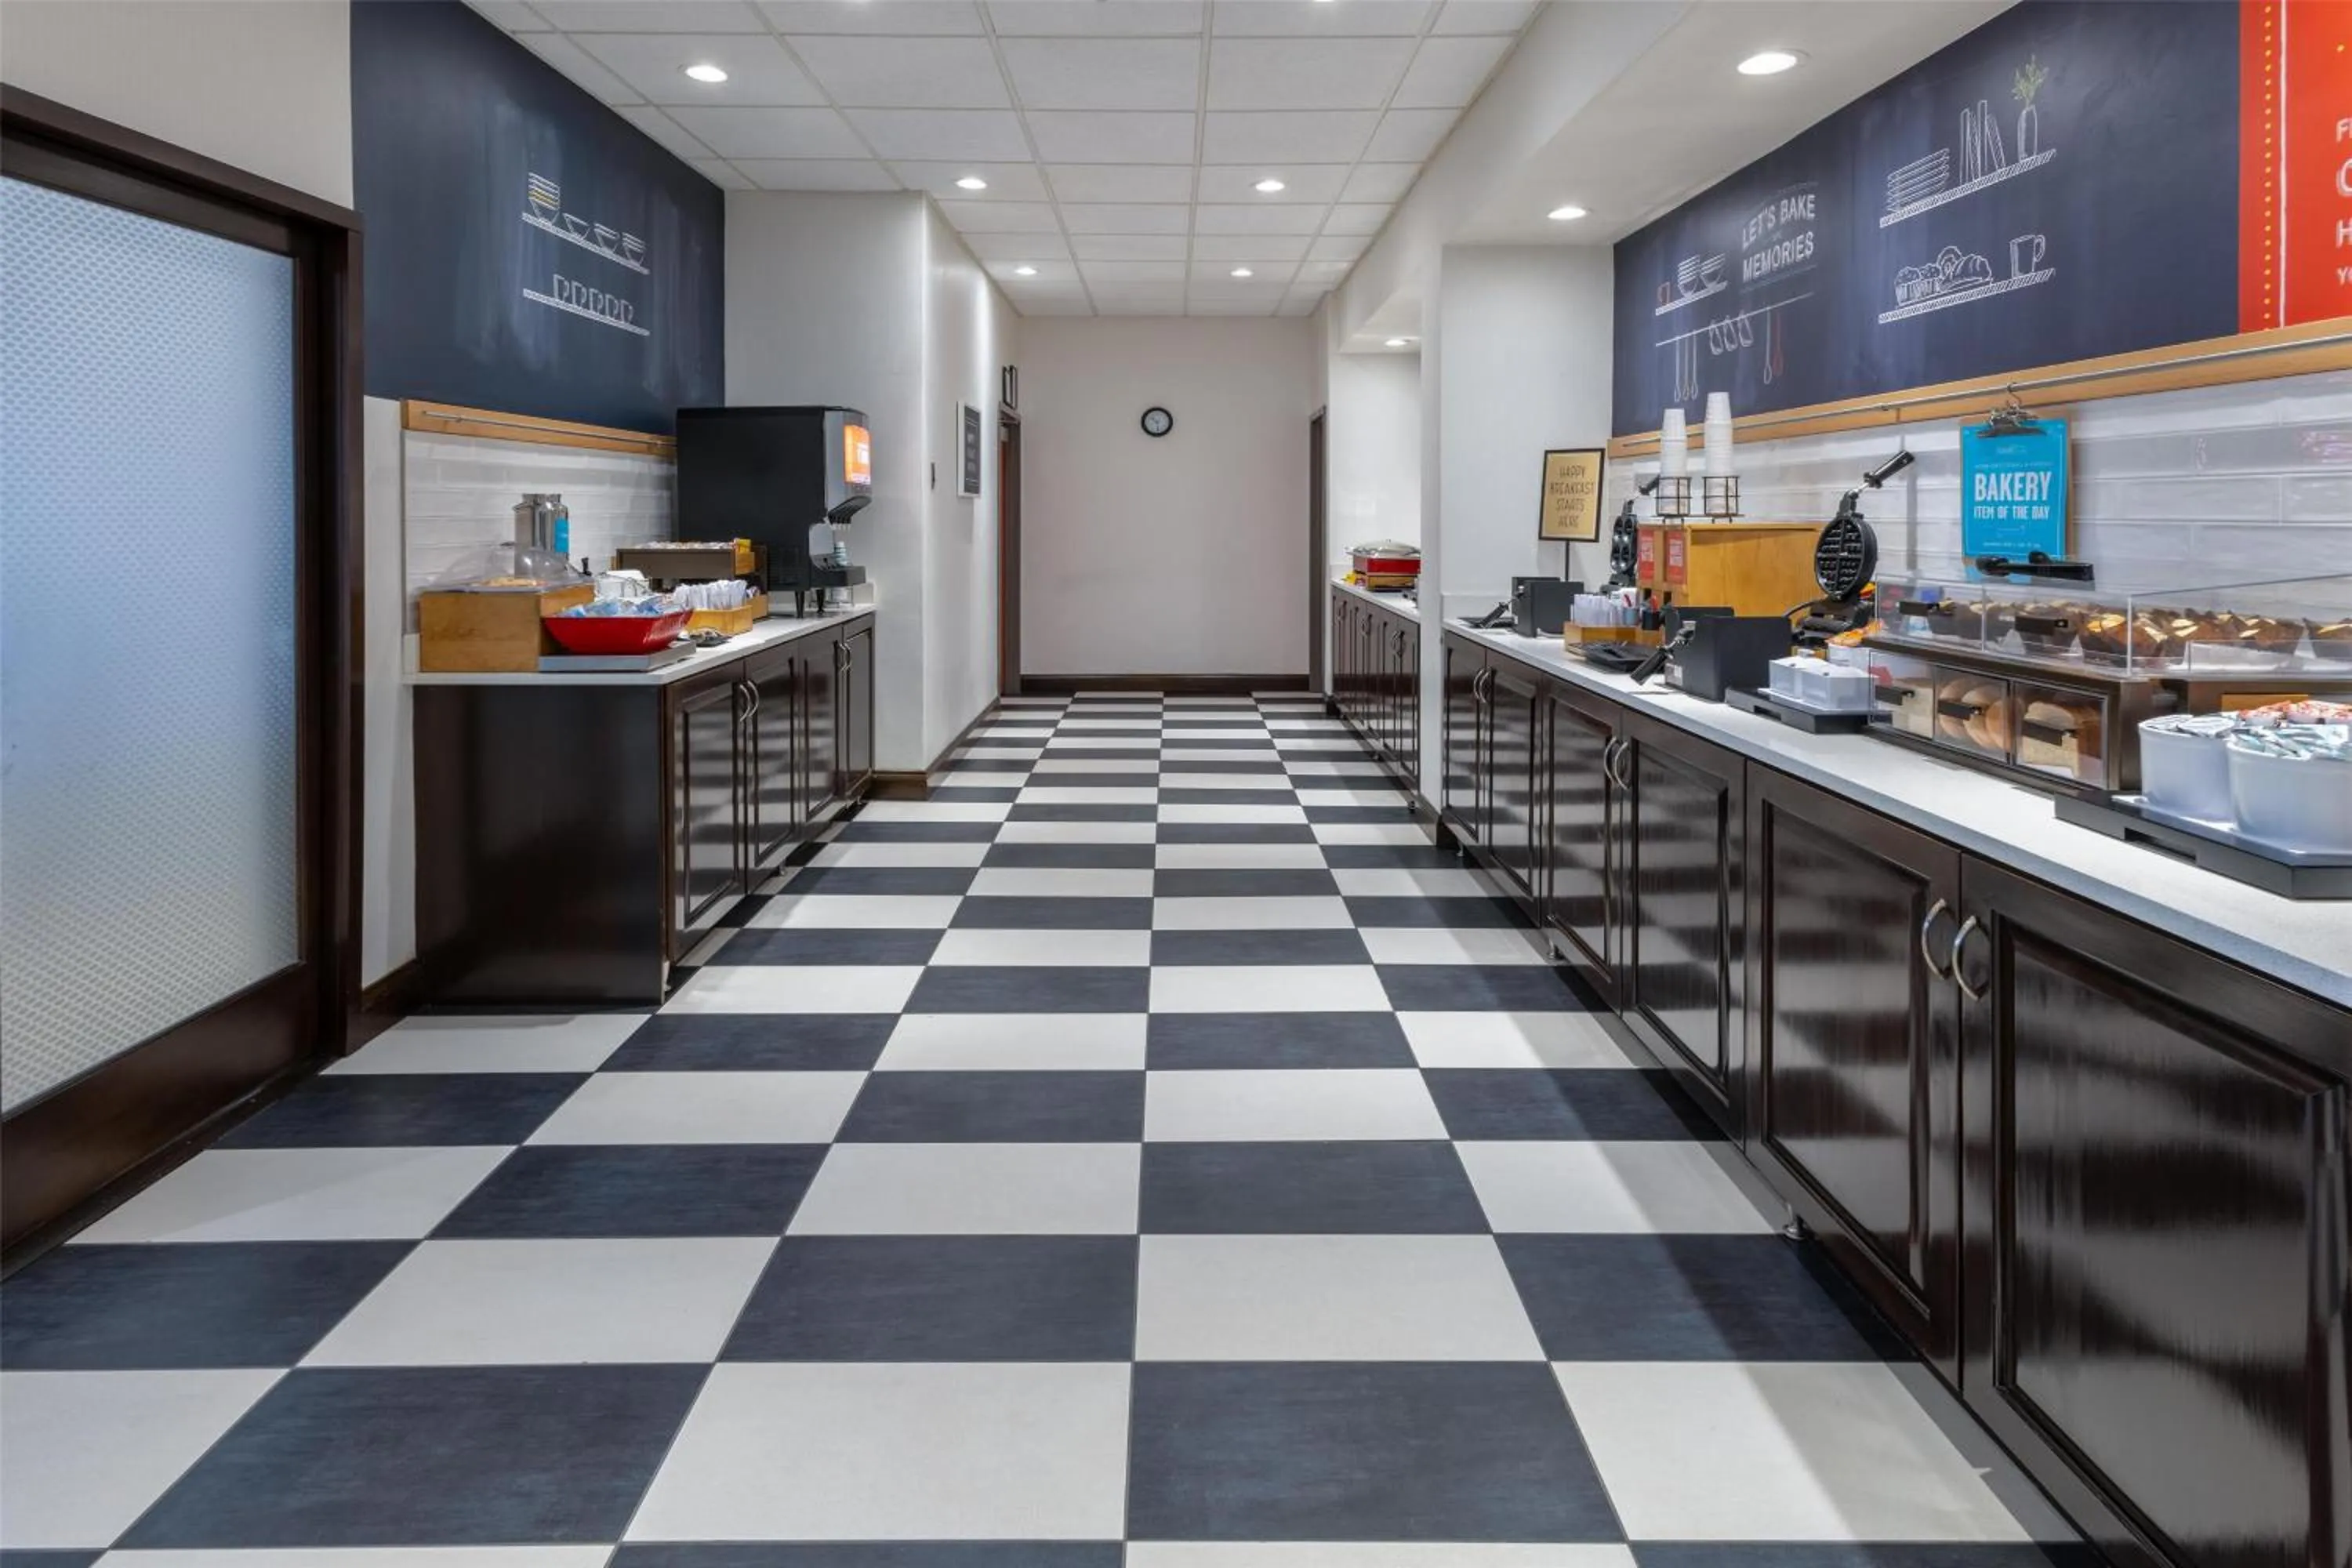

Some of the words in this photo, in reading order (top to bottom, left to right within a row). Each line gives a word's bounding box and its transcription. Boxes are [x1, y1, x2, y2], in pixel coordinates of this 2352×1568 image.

[1743, 205, 1776, 252] LET'S
[1780, 194, 1816, 224] BAKE
[1743, 231, 1814, 283] MEMORIES
[1974, 472, 2052, 502] BAKERY
[1973, 506, 1994, 519] ITEM
[1997, 506, 2009, 519] OF
[2013, 506, 2029, 519] THE
[2032, 505, 2050, 519] DAY
